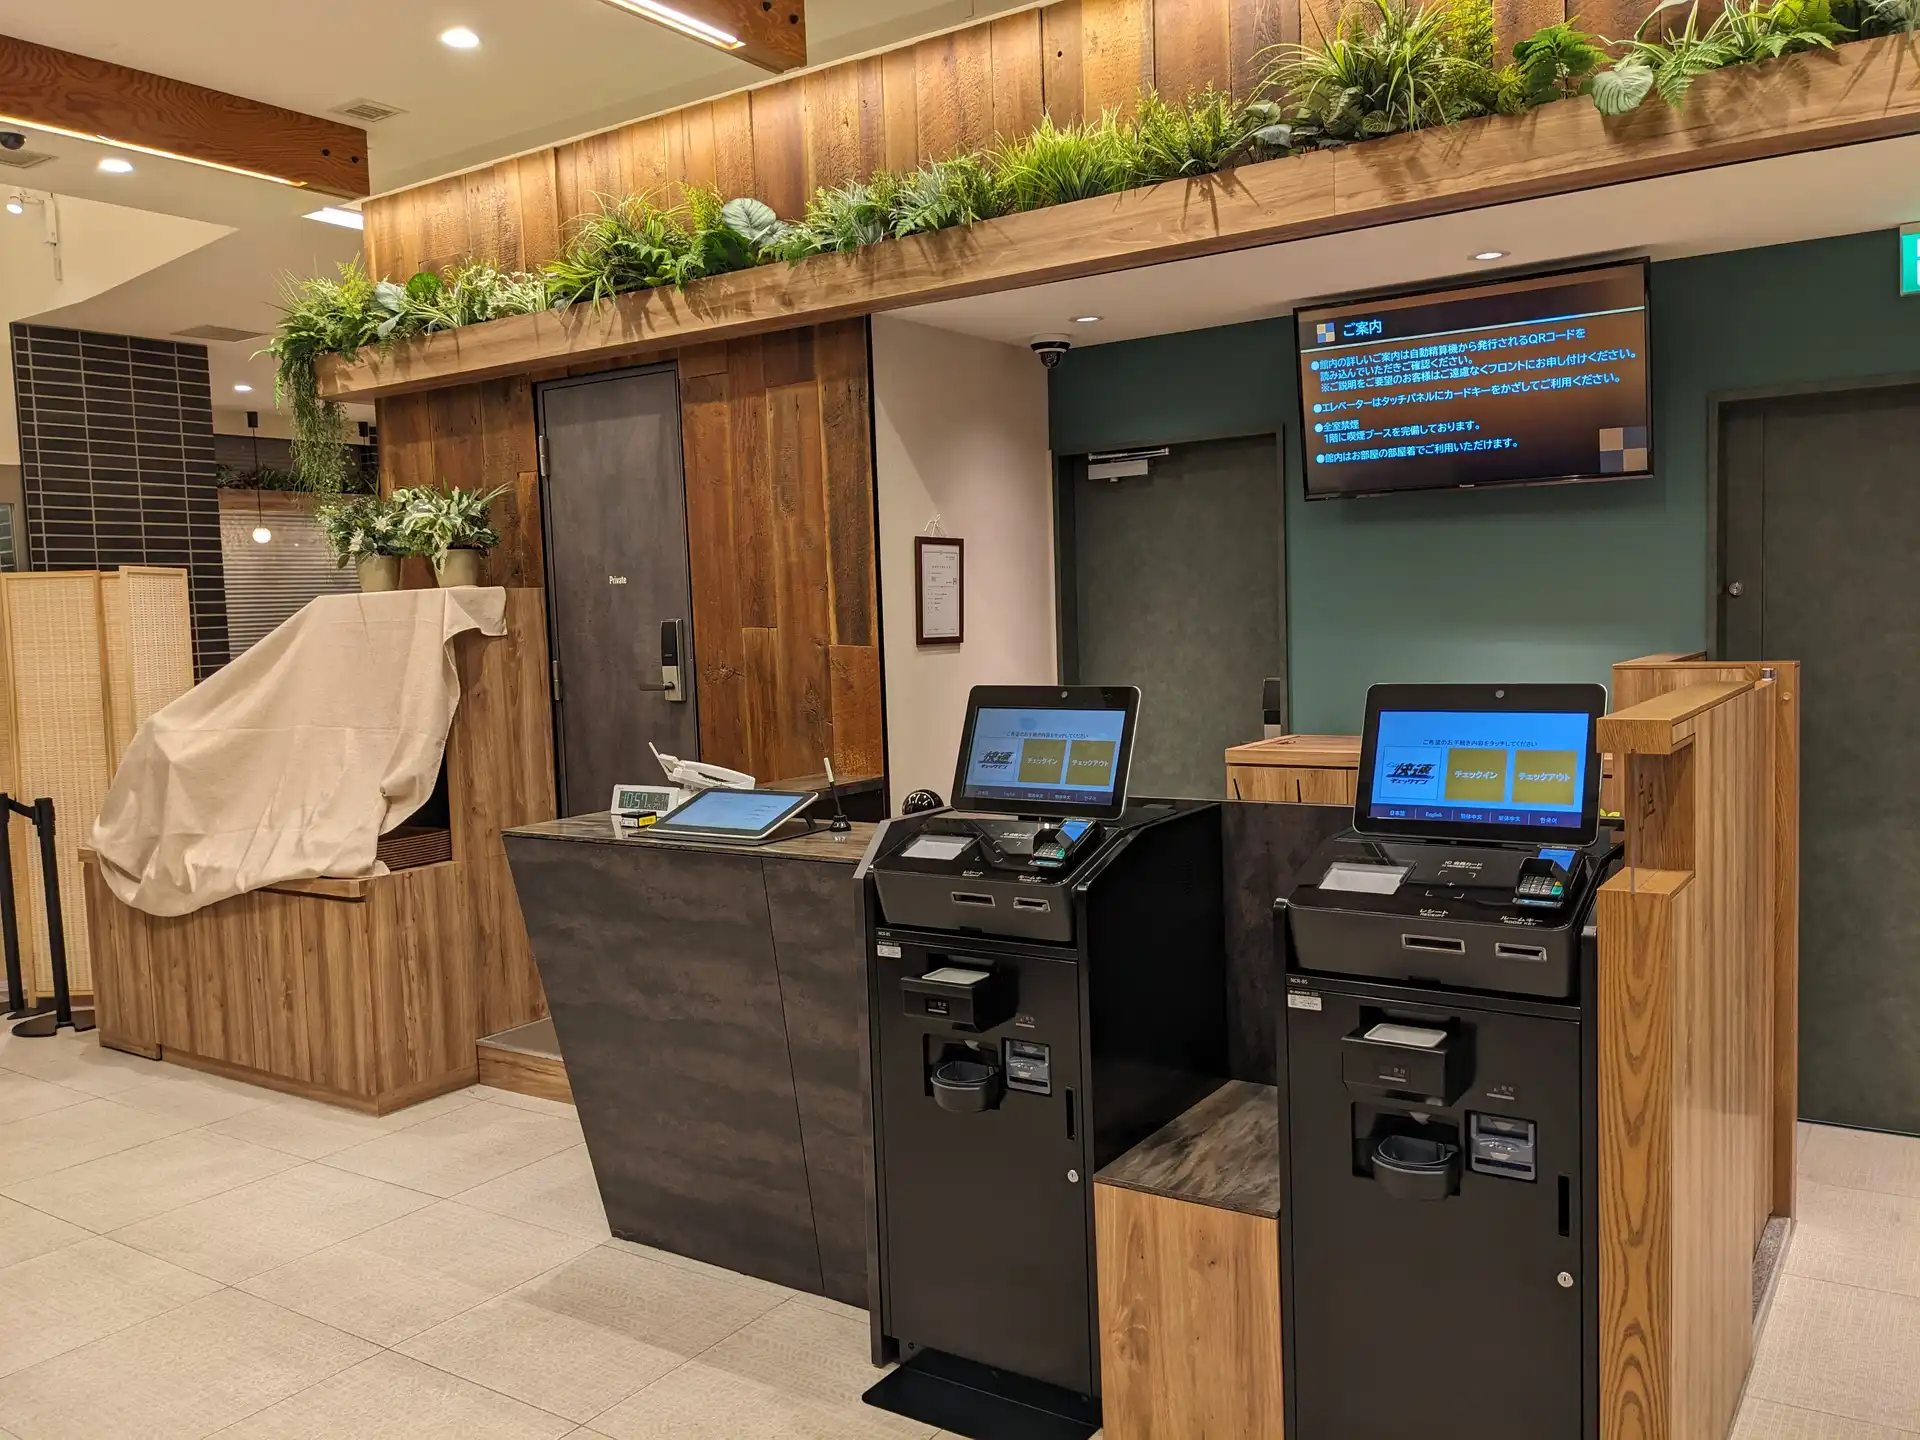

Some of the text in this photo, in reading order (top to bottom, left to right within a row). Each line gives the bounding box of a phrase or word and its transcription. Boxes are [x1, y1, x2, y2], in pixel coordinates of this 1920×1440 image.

[1343, 319, 1382, 337] ご案内
[1320, 328, 1586, 370] 館内の詳しいご案内は自動精算機から発行されるQRコードを
[1320, 355, 1473, 382] 読み込んでいただきご確認ください。
[1323, 419, 1360, 433] 全室禁煙
[1324, 420, 1480, 444] 1階に喫煙ブースを完備しております。
[1324, 437, 1518, 463] 館内はお部屋の部屋着でご利用いただけます。
[608, 575, 627, 585] Private
[1027, 757, 1058, 765] チェックイン
[1072, 759, 1109, 767] チェックアウト
[1454, 769, 1498, 780] チェックイン
[1518, 772, 1571, 783] チェックアウト
